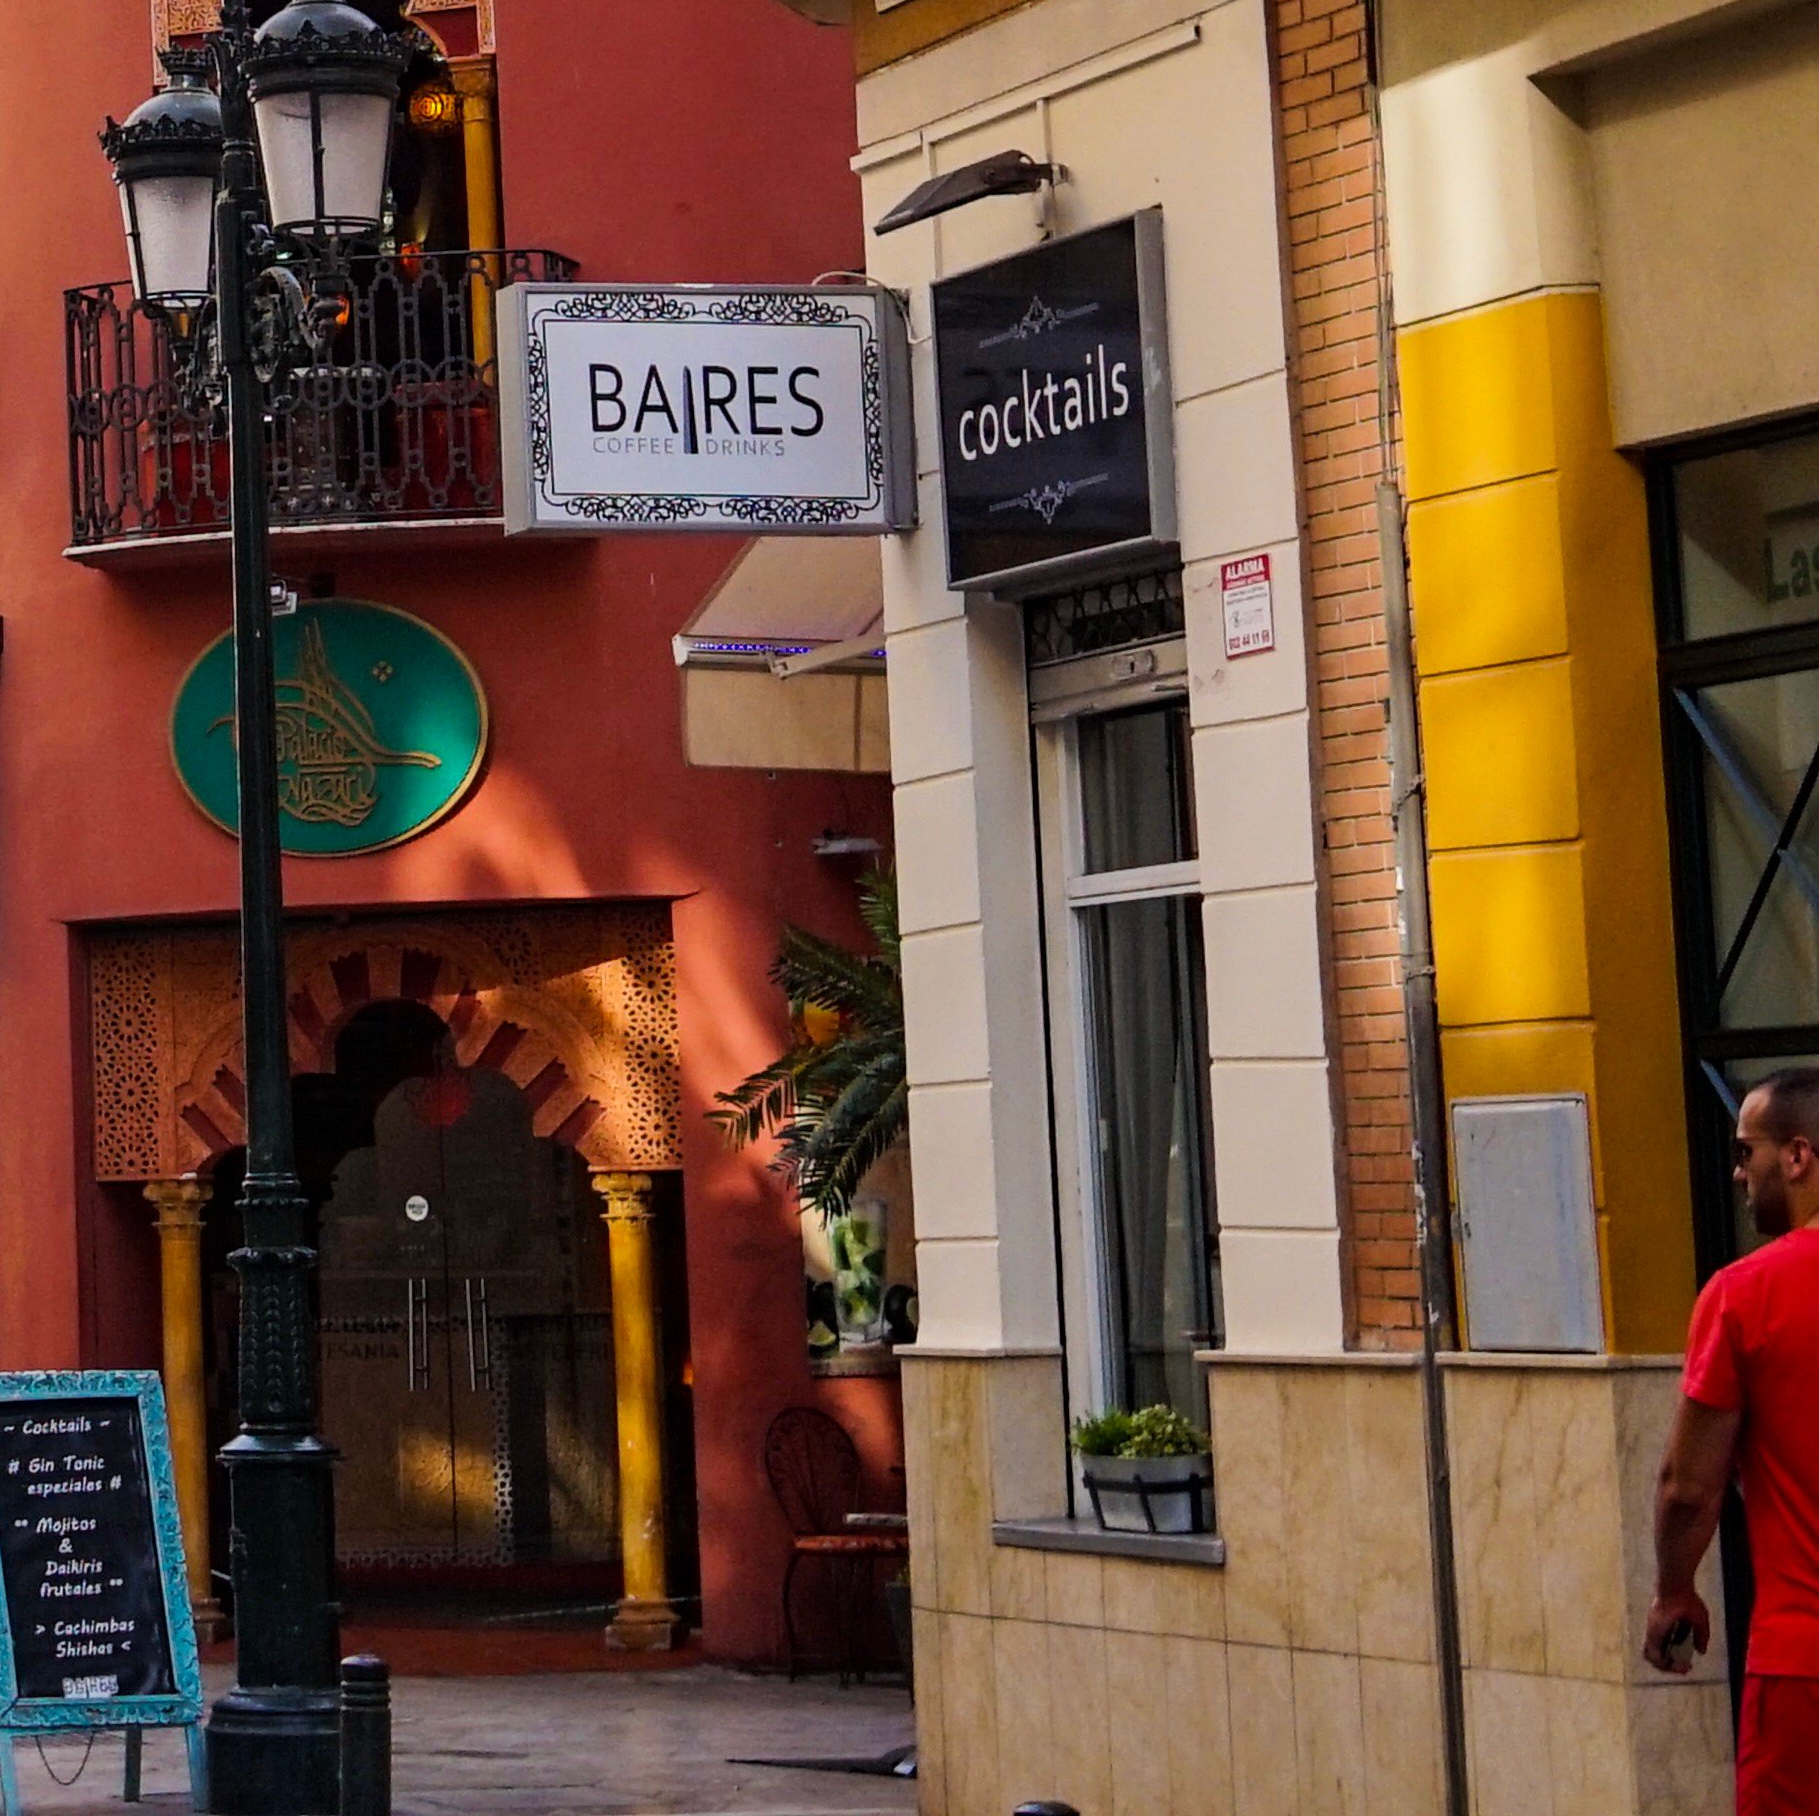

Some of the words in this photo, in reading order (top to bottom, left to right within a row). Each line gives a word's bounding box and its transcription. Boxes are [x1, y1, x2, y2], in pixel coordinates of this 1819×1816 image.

[589, 363, 824, 453] BAIRES
[959, 343, 1129, 461] cocktails
[593, 437, 673, 454] COFFEE
[706, 438, 785, 457] DRINKS
[23, 1417, 91, 1435] Cocktails
[29, 1458, 54, 1473] Gin
[64, 1455, 105, 1471] Tonic
[27, 1477, 102, 1498] especiales
[36, 1516, 97, 1535] Mojitos
[59, 1538, 72, 1554] &
[45, 1560, 103, 1577] Daikiris
[40, 1582, 102, 1598] frutales
[54, 1619, 135, 1636] Cachimbas
[56, 1641, 113, 1658] Shishas
